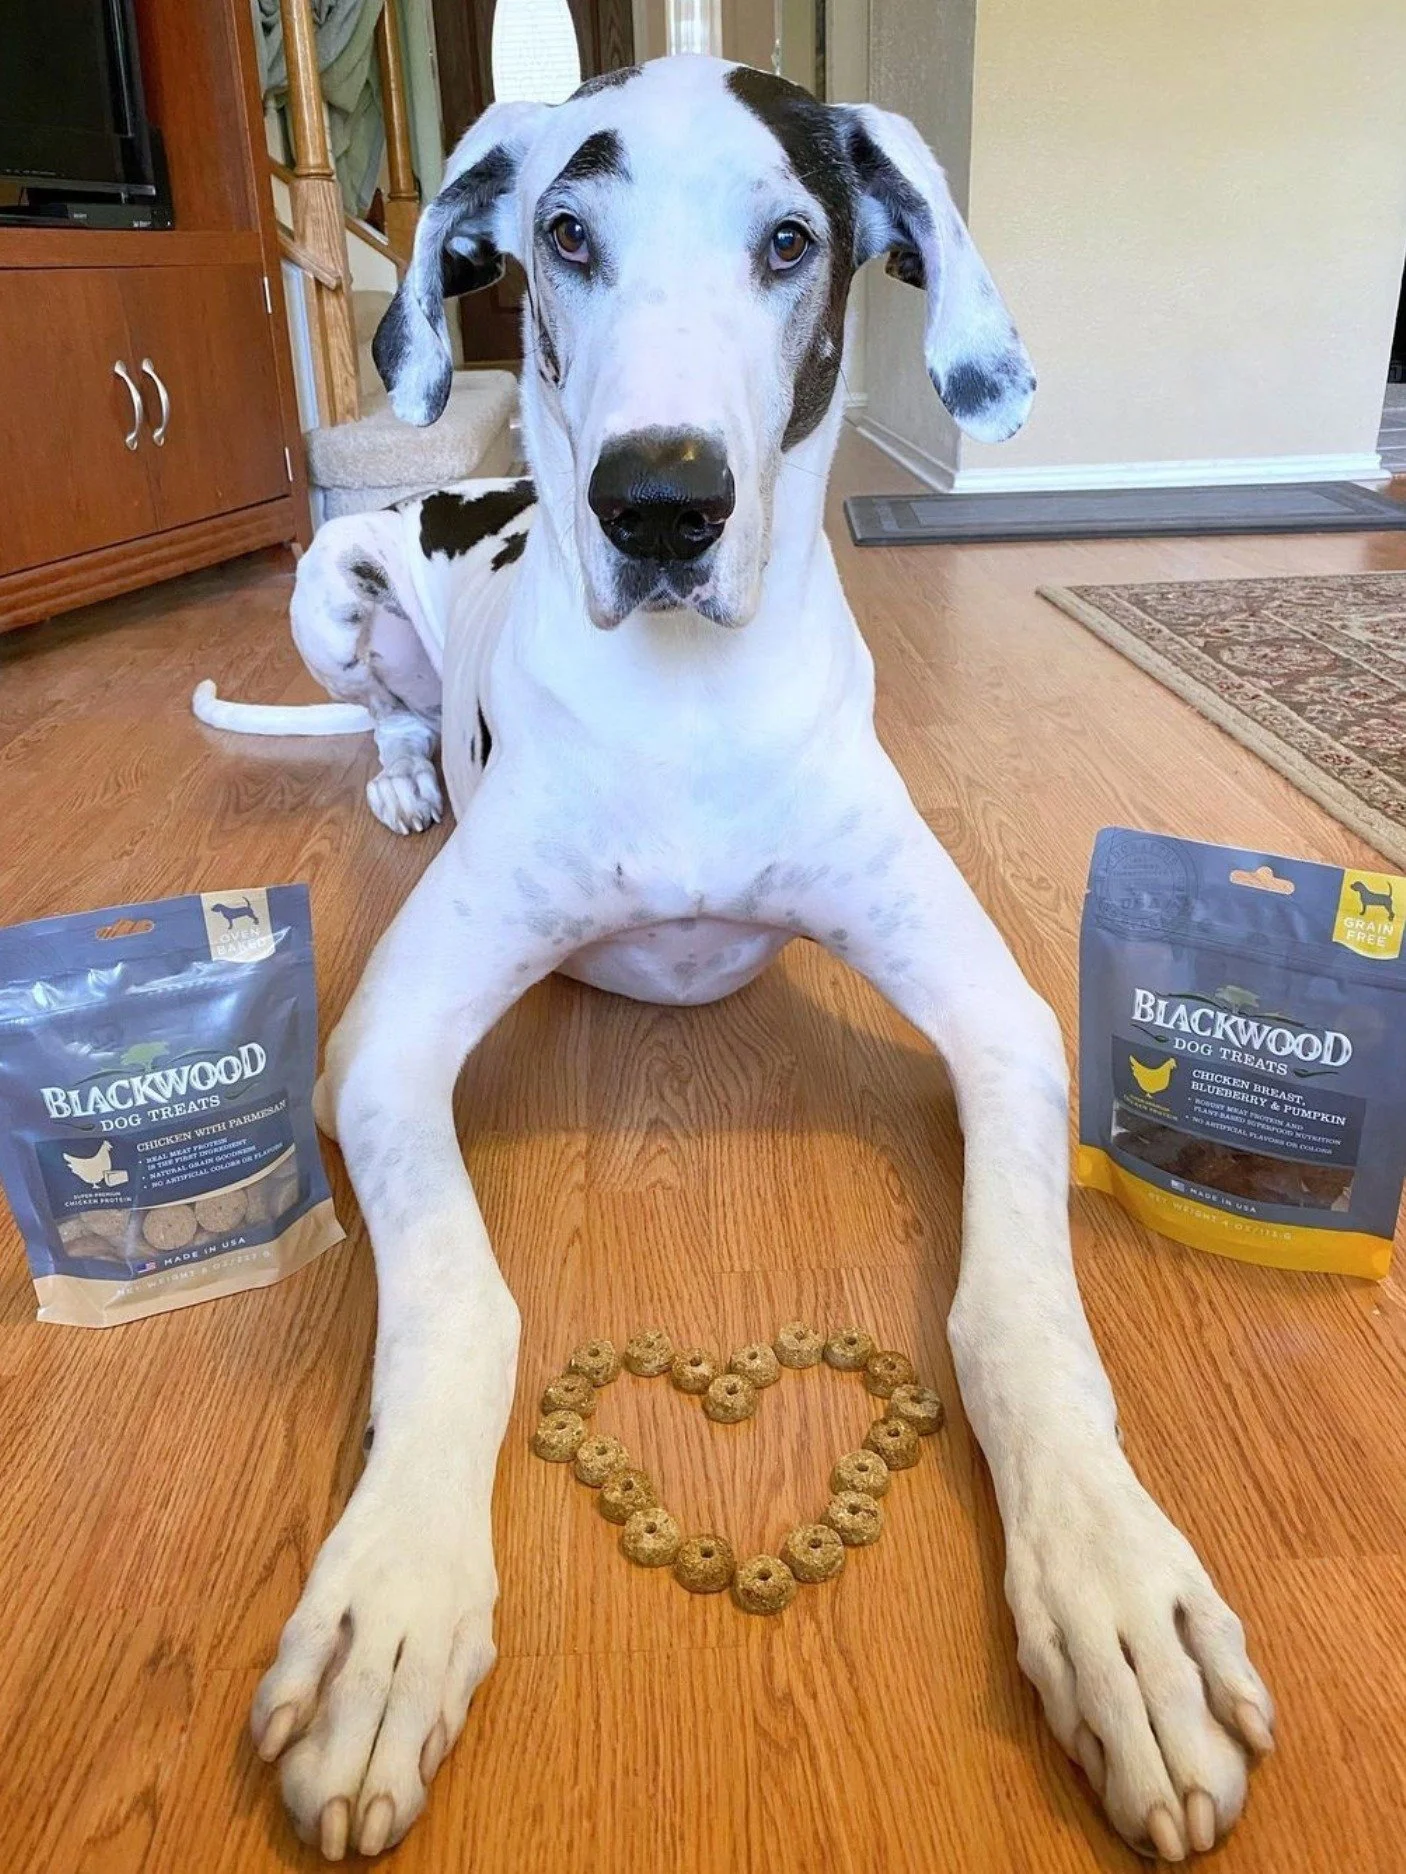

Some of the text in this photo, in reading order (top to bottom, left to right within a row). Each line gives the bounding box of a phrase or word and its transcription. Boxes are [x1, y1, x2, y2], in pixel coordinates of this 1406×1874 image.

[1344, 917, 1393, 936] GRAIN
[1347, 929, 1386, 947] FREE
[1132, 988, 1353, 1067] BLACKWOOD
[1173, 1037, 1288, 1076] DOG TREATS
[40, 1042, 267, 1119] BLACKWOOD
[1192, 1069, 1250, 1090] CHICKEN
[101, 1095, 221, 1132] DOG TREATS
[1191, 1081, 1268, 1107] BLUEBERRY
[1271, 1101, 1281, 1111] &
[1284, 1103, 1346, 1126] PUMPKIN
[136, 1100, 288, 1152] CHICKEN WITH PARMESAN
[1295, 1131, 1341, 1146] NUTRITION
[157, 1158, 173, 1168] THE
[175, 1152, 198, 1164] FIRST
[170, 1147, 191, 1157] MEAT
[150, 1165, 187, 1179] NATURAL
[188, 1157, 214, 1169] GRAIN
[152, 1180, 163, 1188] NO
[165, 1170, 209, 1185] ARTIFICIAL
[64, 1198, 98, 1207] CHICKEN
[1190, 1187, 1257, 1213] MADE IN USA
[1173, 1202, 1217, 1223] WEIGHT
[164, 1237, 246, 1266] MADE IN USA
[147, 1270, 195, 1288] WEIGHT
